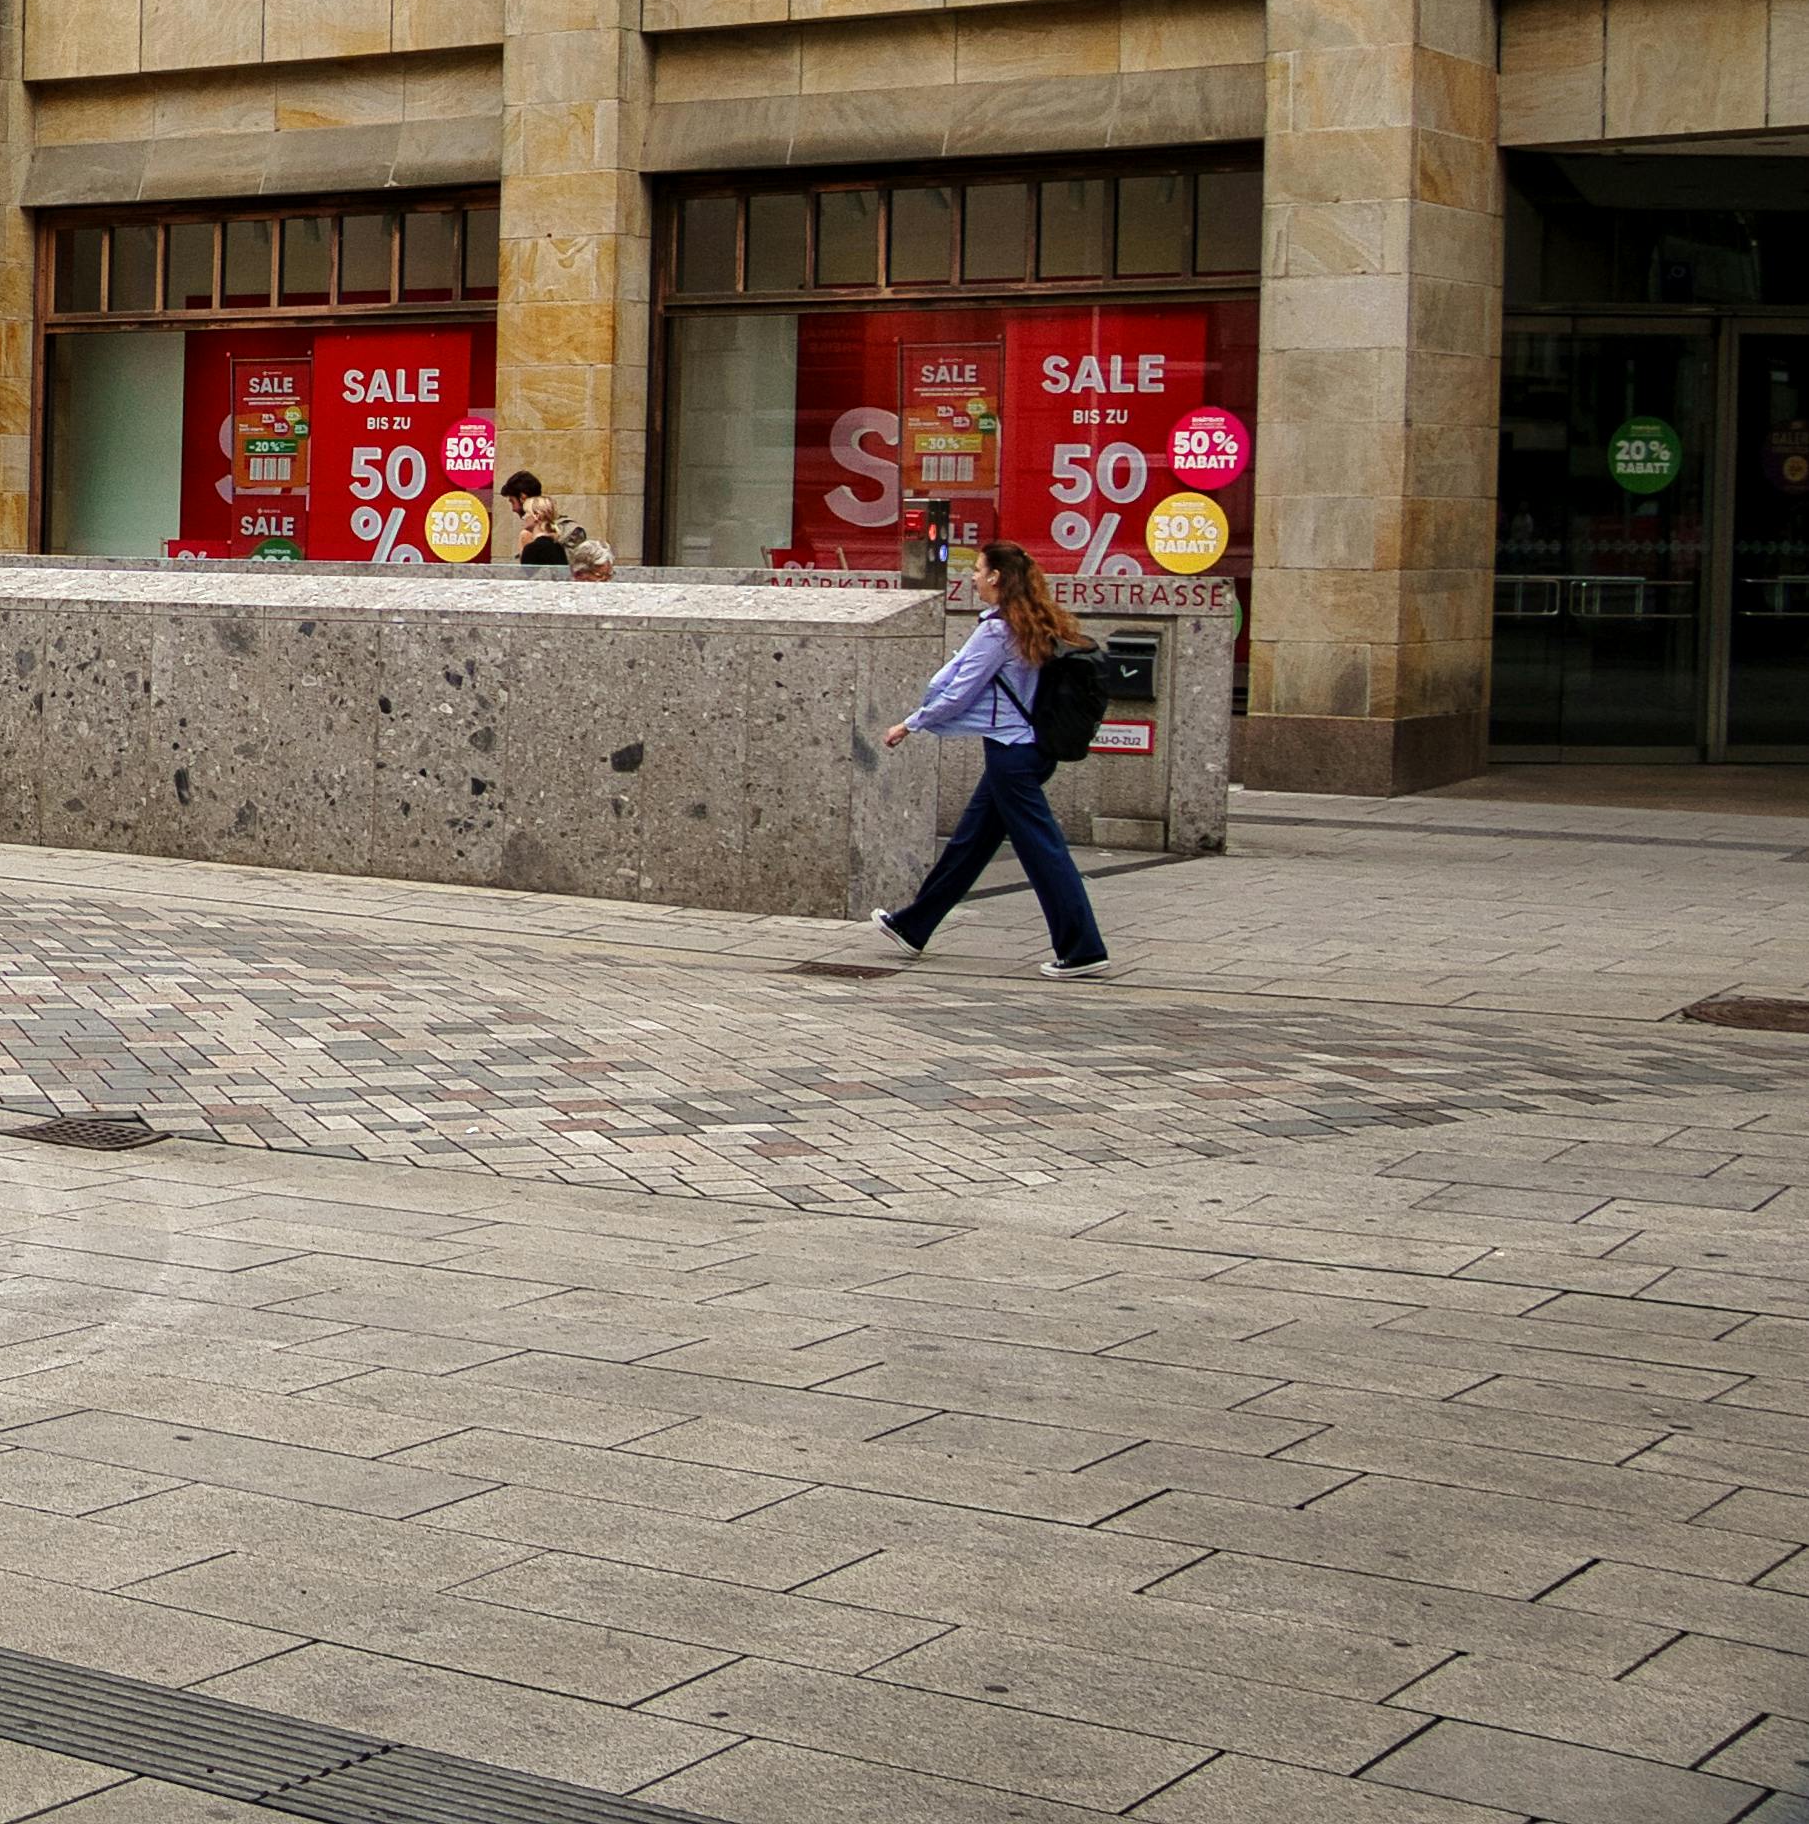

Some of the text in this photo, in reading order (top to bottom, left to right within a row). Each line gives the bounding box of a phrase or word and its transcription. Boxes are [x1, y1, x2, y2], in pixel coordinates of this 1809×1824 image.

[920, 364, 978, 383] SALE
[1040, 354, 1166, 394] SALE
[248, 376, 294, 394] SALE
[341, 368, 441, 404] SALE
[366, 416, 411, 430] BIS ZU
[1072, 409, 1129, 425] BIS ZU
[446, 458, 495, 471] RABATT
[1173, 455, 1238, 470] RABATT
[1616, 462, 1671, 474] RABATT
[349, 445, 427, 501] 50
[1049, 441, 1148, 505] 50
[240, 515, 295, 536] SALE
[948, 522, 979, 545] LE
[432, 533, 481, 546] RABATT
[1154, 540, 1217, 554] RABATT
